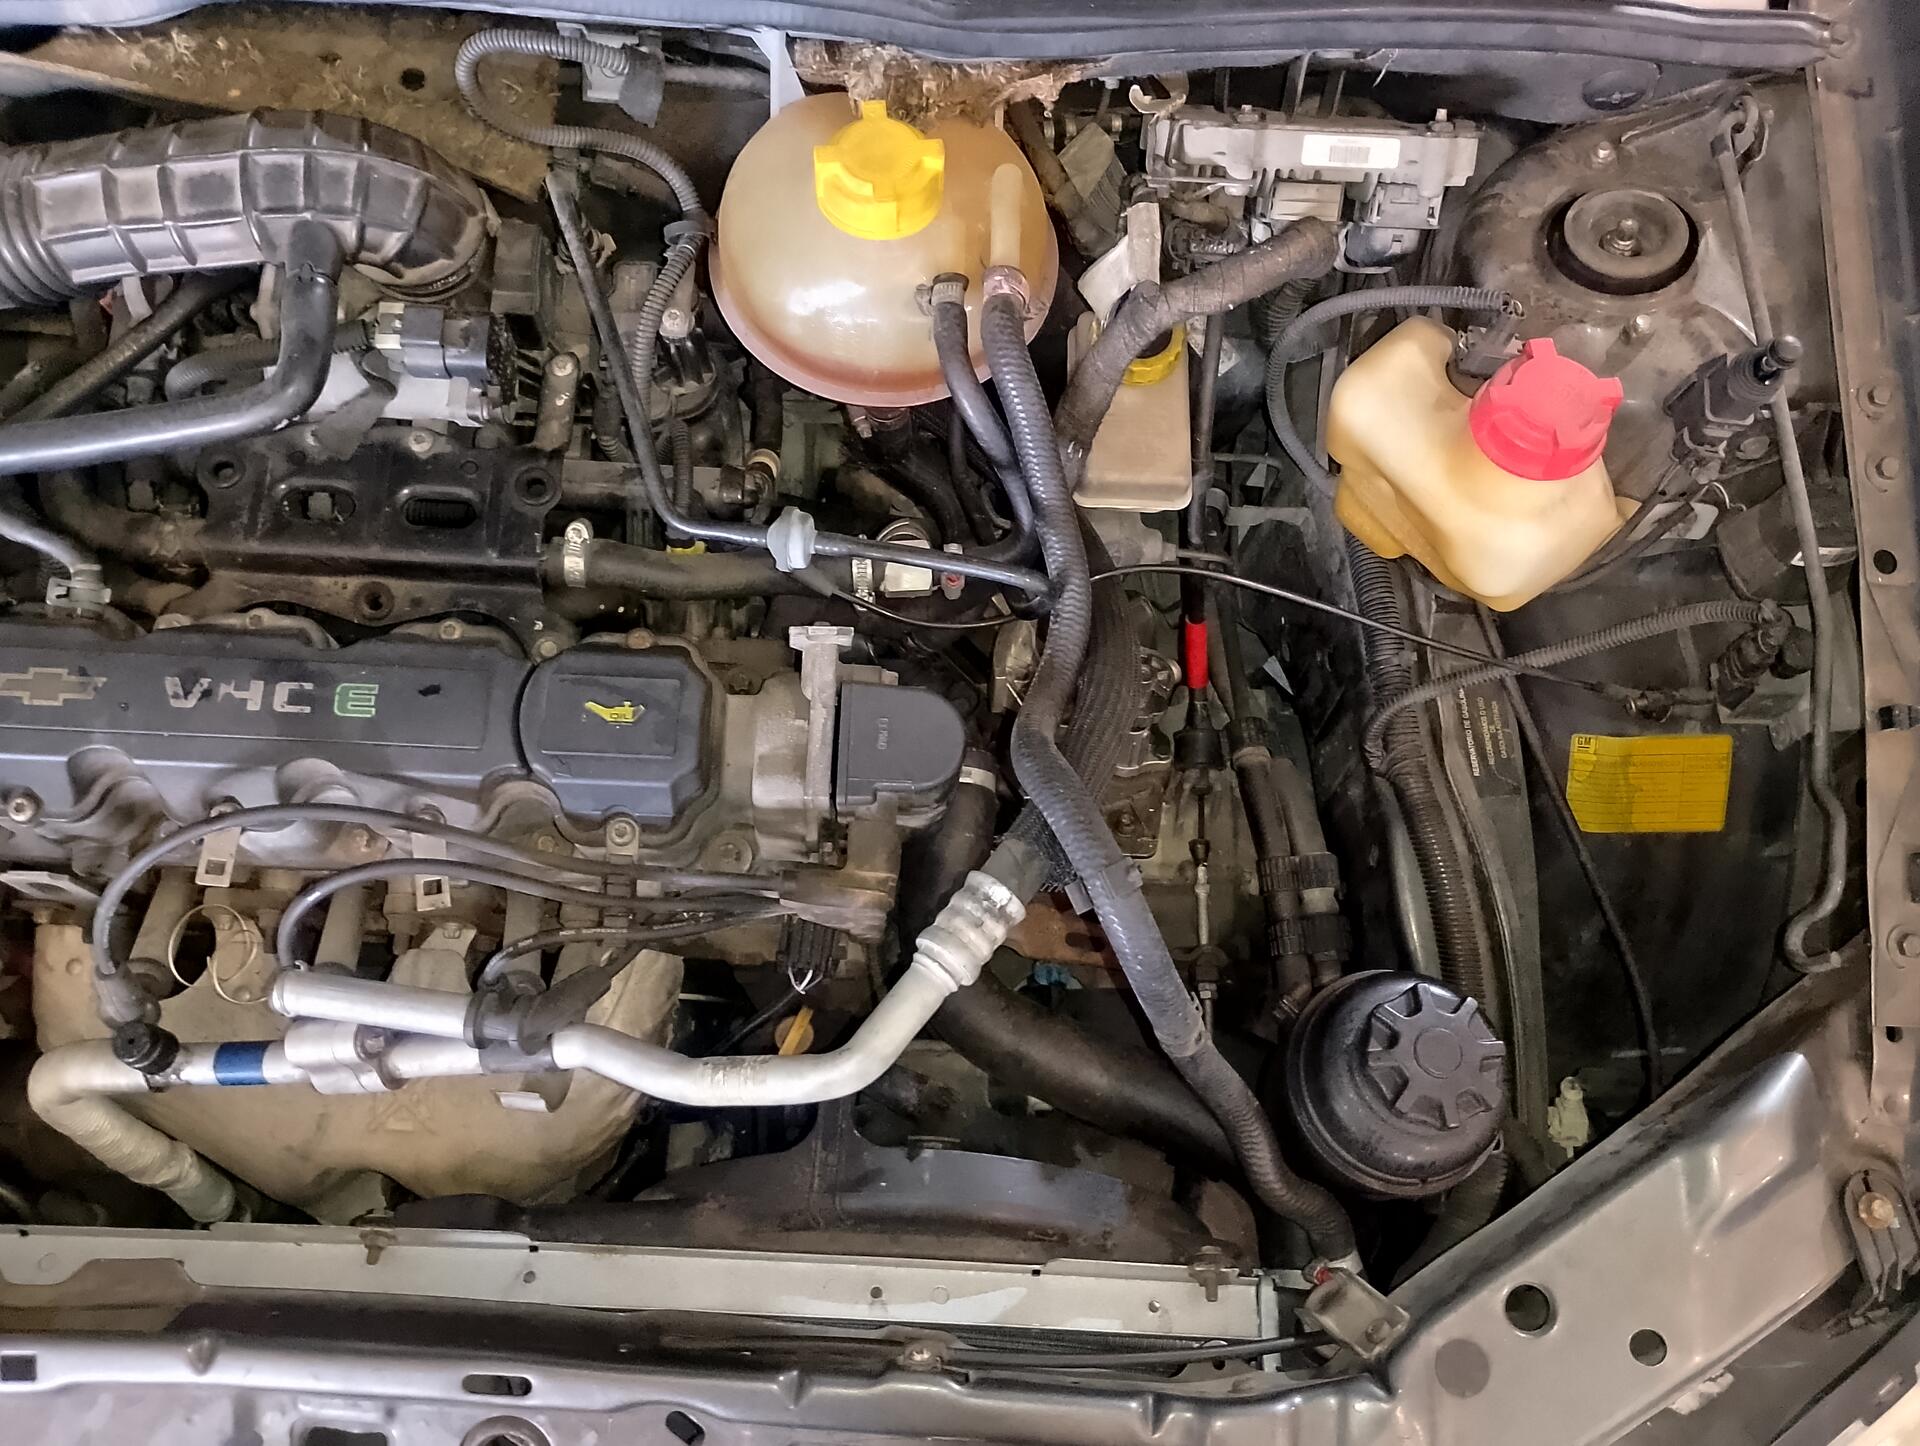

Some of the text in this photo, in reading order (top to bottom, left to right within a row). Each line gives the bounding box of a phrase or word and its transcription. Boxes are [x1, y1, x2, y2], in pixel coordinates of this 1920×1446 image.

[609, 712, 631, 720] OIL
[1464, 720, 1471, 728] DE
[1577, 736, 1592, 746] GM
